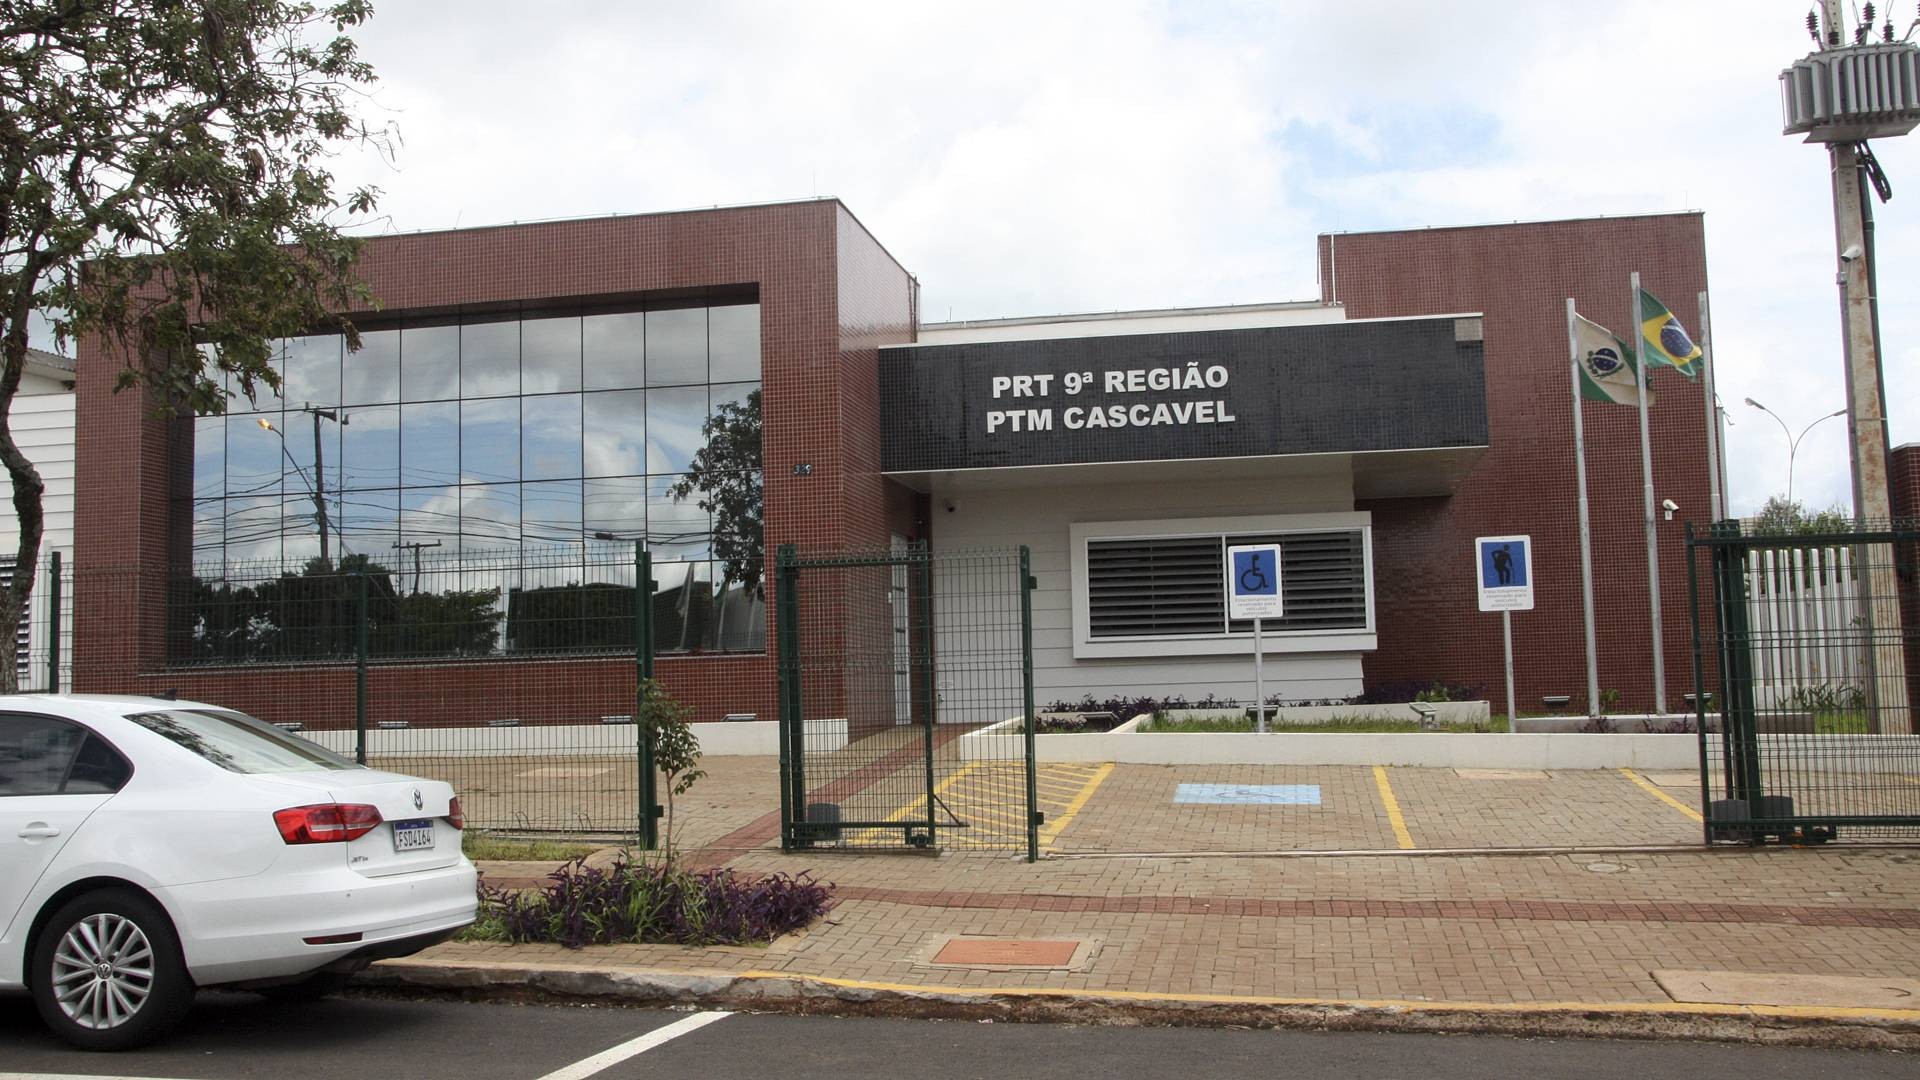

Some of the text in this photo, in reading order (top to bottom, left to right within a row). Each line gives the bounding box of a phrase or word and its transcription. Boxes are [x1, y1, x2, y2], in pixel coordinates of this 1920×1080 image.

[992, 361, 1229, 398] PRT 9ª REGIÃO
[986, 401, 1236, 433] PTM CASCAVEL
